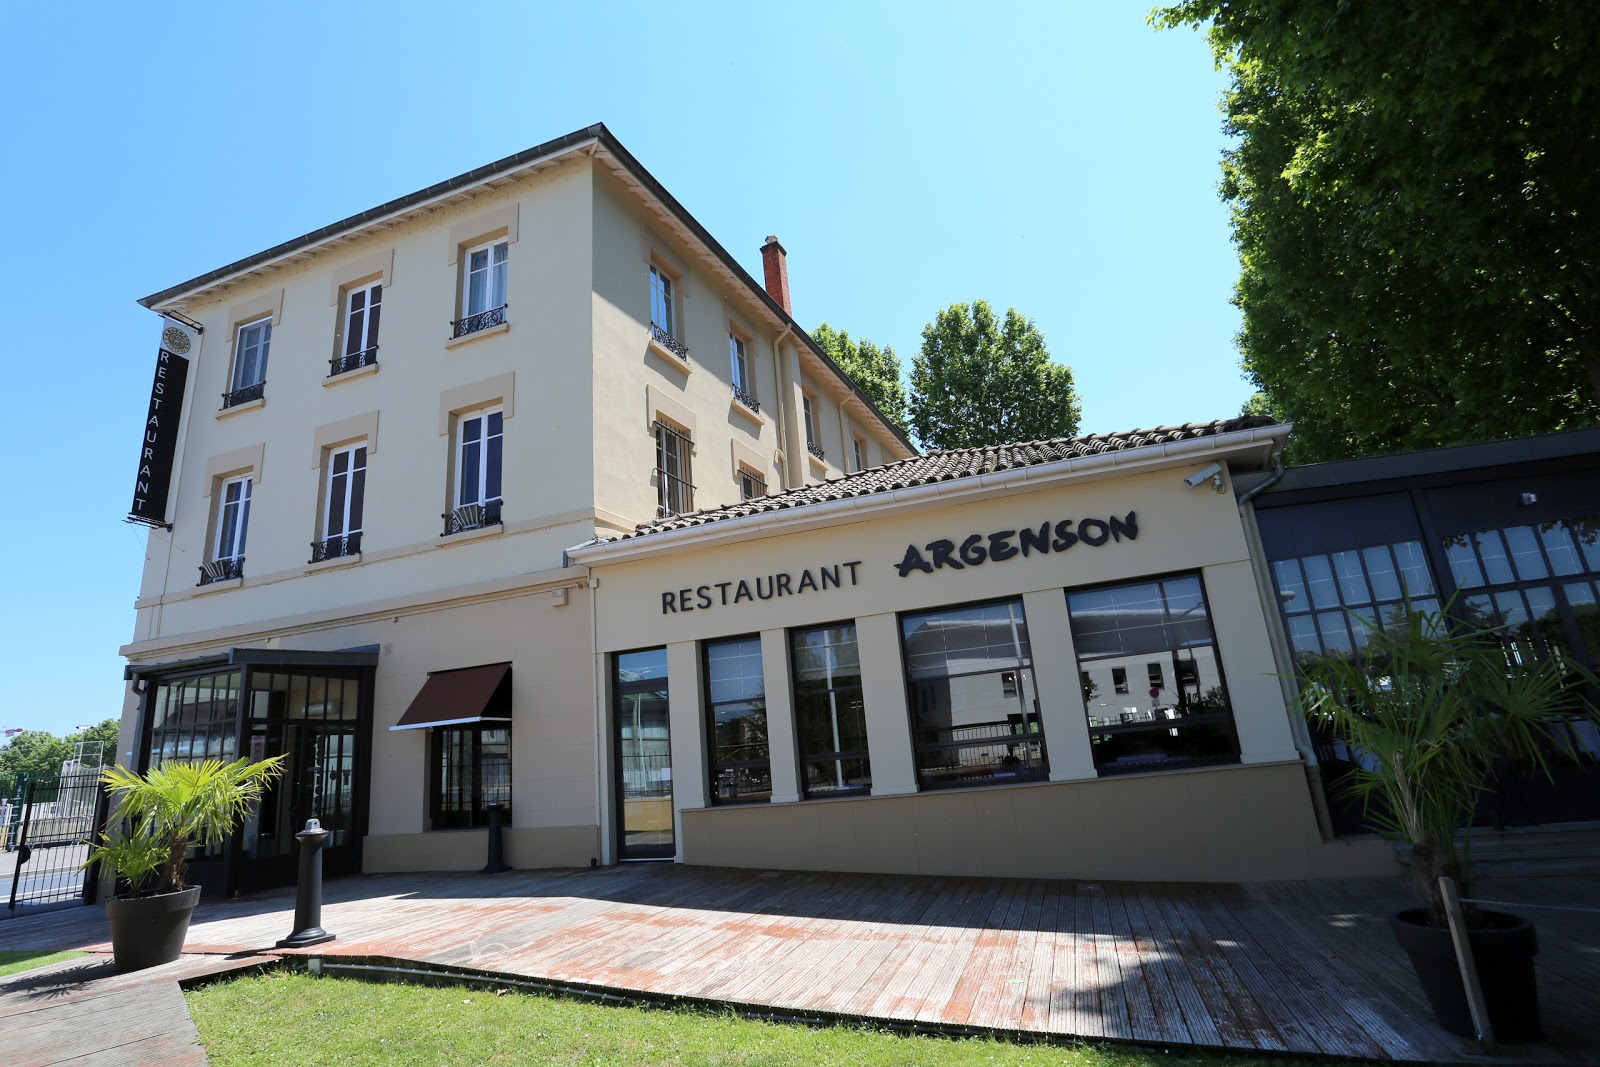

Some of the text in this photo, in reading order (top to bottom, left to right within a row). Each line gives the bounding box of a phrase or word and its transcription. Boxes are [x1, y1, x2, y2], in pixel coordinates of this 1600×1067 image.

[136, 351, 169, 511] RESTAURANT
[661, 510, 1139, 615] RESTAURANT ARGENSON
